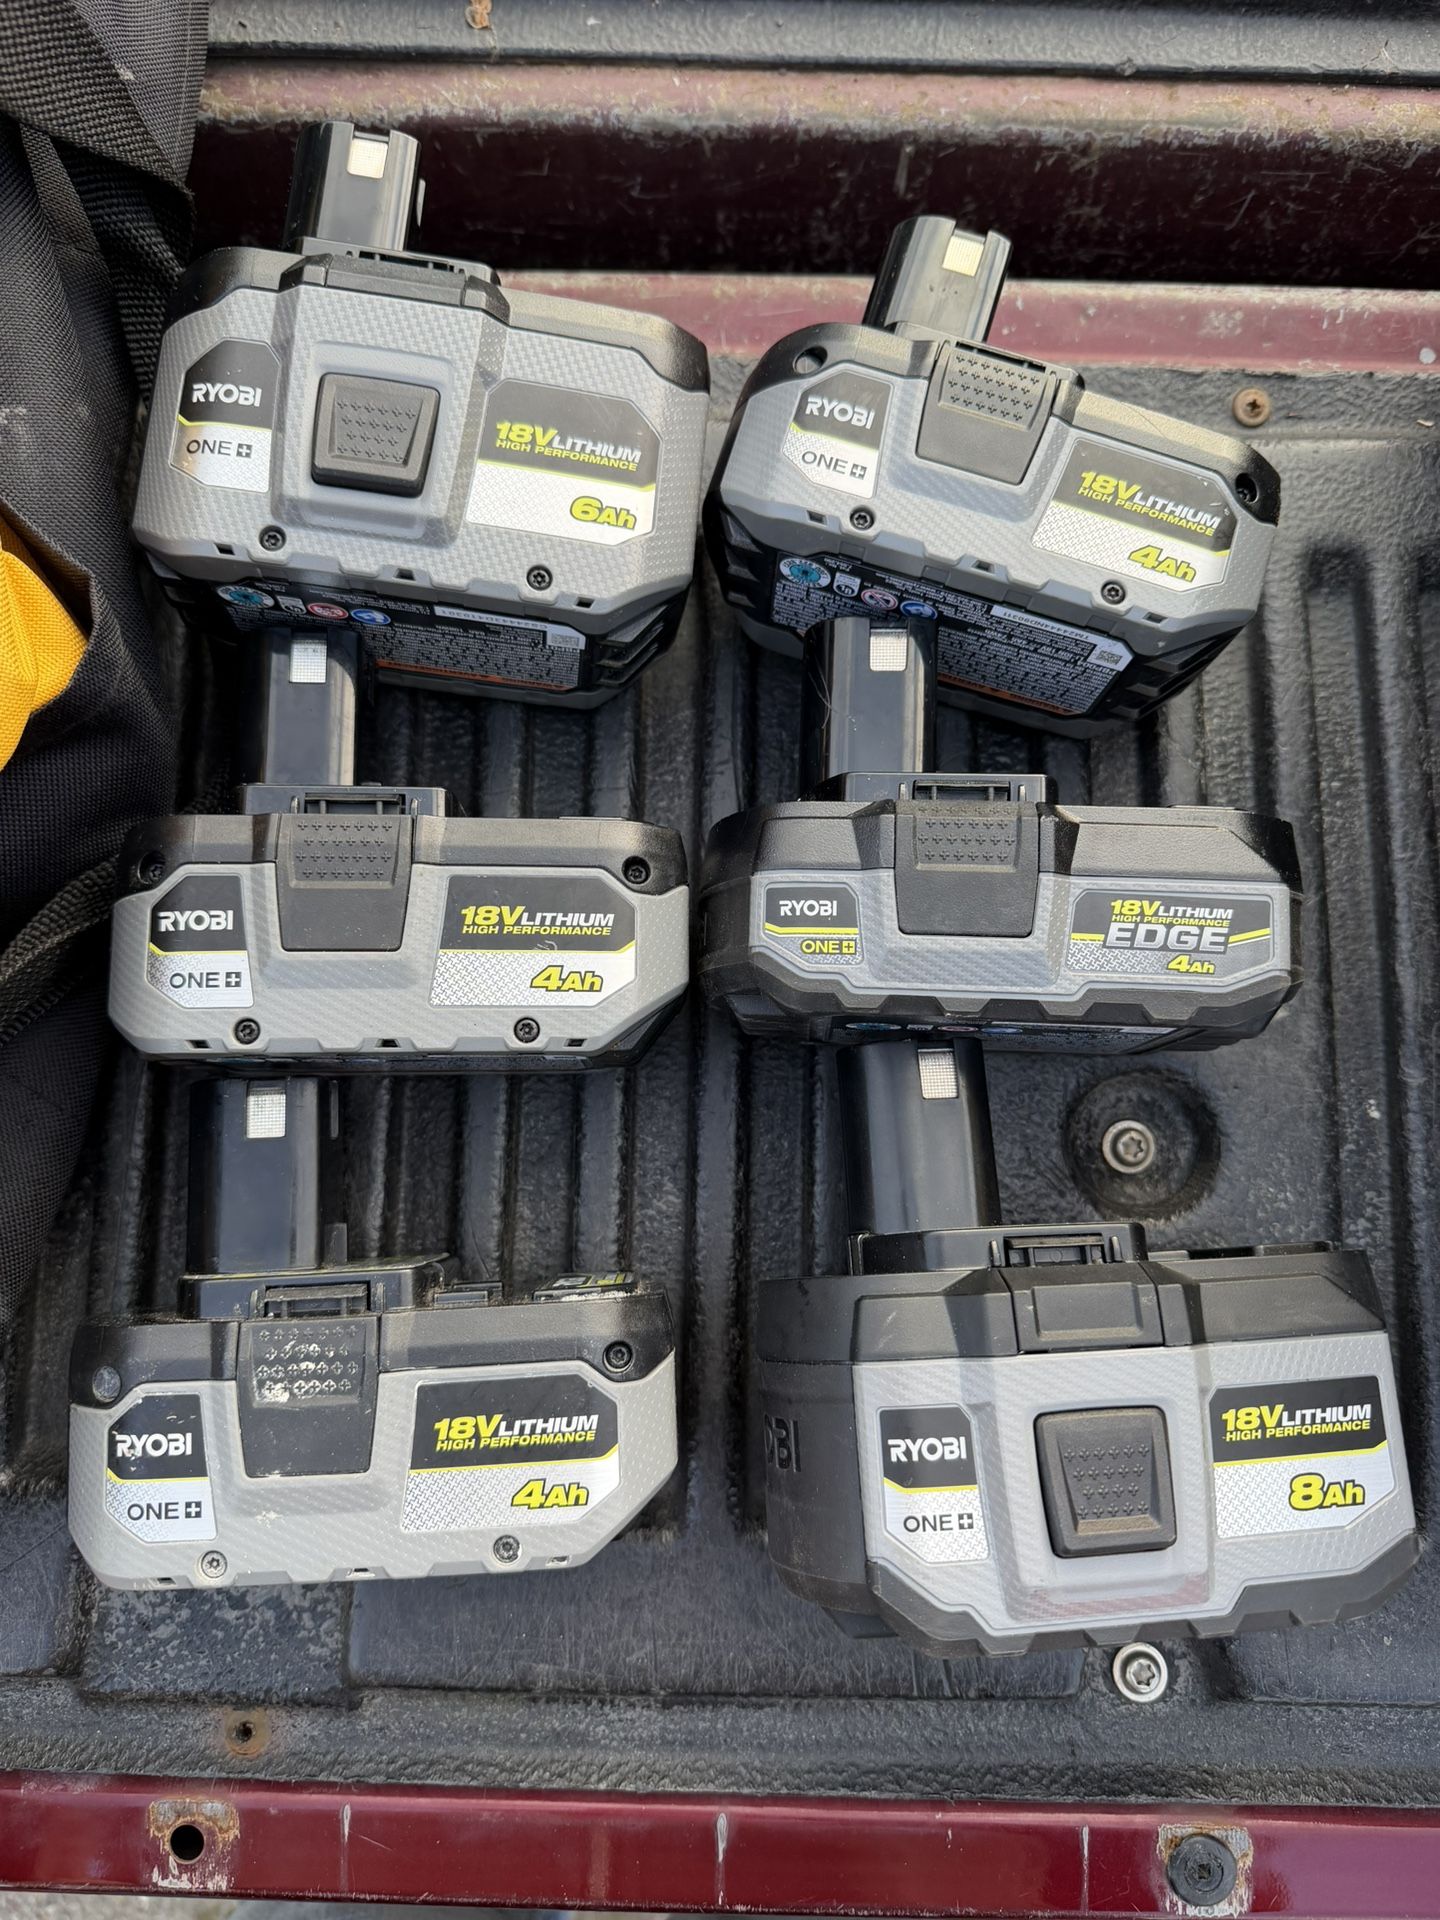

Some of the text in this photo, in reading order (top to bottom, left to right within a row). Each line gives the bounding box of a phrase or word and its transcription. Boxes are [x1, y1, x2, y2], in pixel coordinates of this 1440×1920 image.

[192, 382, 262, 407] RYOBI
[805, 395, 875, 430] RYOBI
[495, 438, 638, 471] HIGH PERFORMANCE
[569, 495, 637, 531] 6Ah
[1077, 486, 1216, 536] HIGH PERFORMANCE
[1128, 544, 1197, 583] 4Ah
[157, 909, 234, 932] RYOBI
[779, 899, 838, 917] RYOBI
[1111, 915, 1231, 928] HIGH PERFORMANCE
[462, 925, 612, 936] HIGH PERFORMANCE
[1105, 921, 1230, 953] EDGE
[1166, 953, 1216, 974] 4Ah
[530, 965, 604, 992] 4Ah
[436, 1430, 596, 1451] HIGH PERFORMANCE
[1225, 1420, 1371, 1442] HIGH PERFORMANCE
[115, 1432, 193, 1458] RYOBI
[887, 1436, 967, 1463] RYOBI
[511, 1478, 590, 1510] 4Ah
[1288, 1472, 1366, 1511] 8Ah
